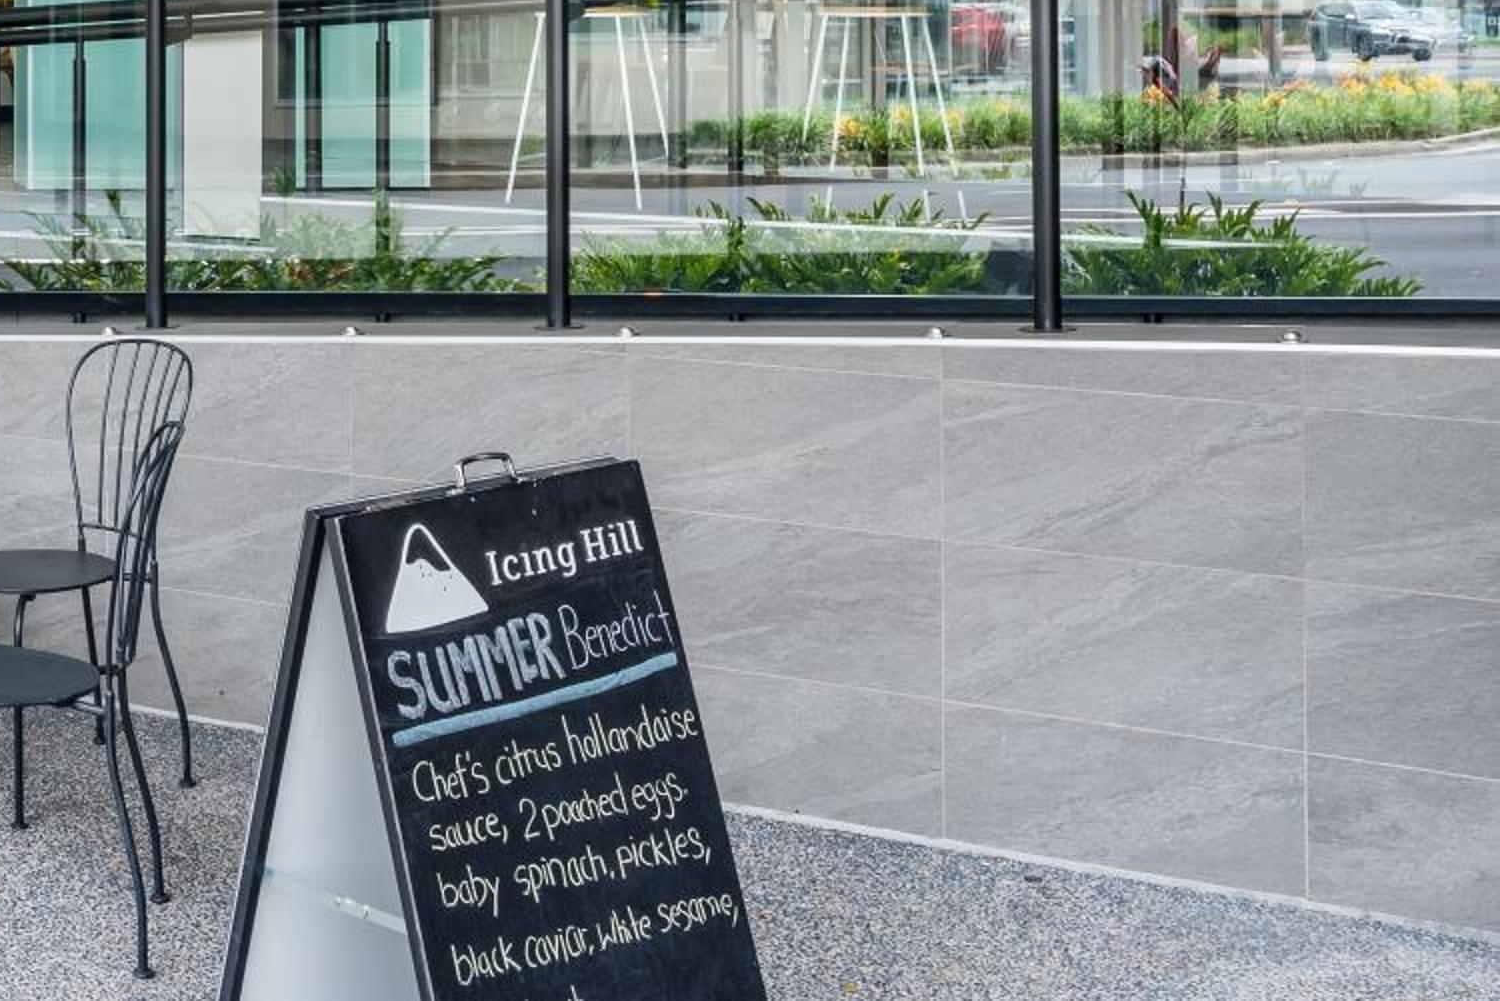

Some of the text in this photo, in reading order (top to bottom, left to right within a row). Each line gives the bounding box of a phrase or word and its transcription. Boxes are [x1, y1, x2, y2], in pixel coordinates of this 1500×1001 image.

[486, 519, 644, 586] Icing Hill
[387, 590, 676, 719] SUMMER Benedict
[412, 704, 698, 802] Chef's citrus hollandaise
[429, 812, 509, 850] sauce,
[518, 798, 541, 842] 2
[541, 771, 629, 841] poached
[436, 863, 500, 918] baby
[617, 827, 712, 879] pickles,
[451, 936, 522, 986] black
[657, 893, 739, 933] sesame,
